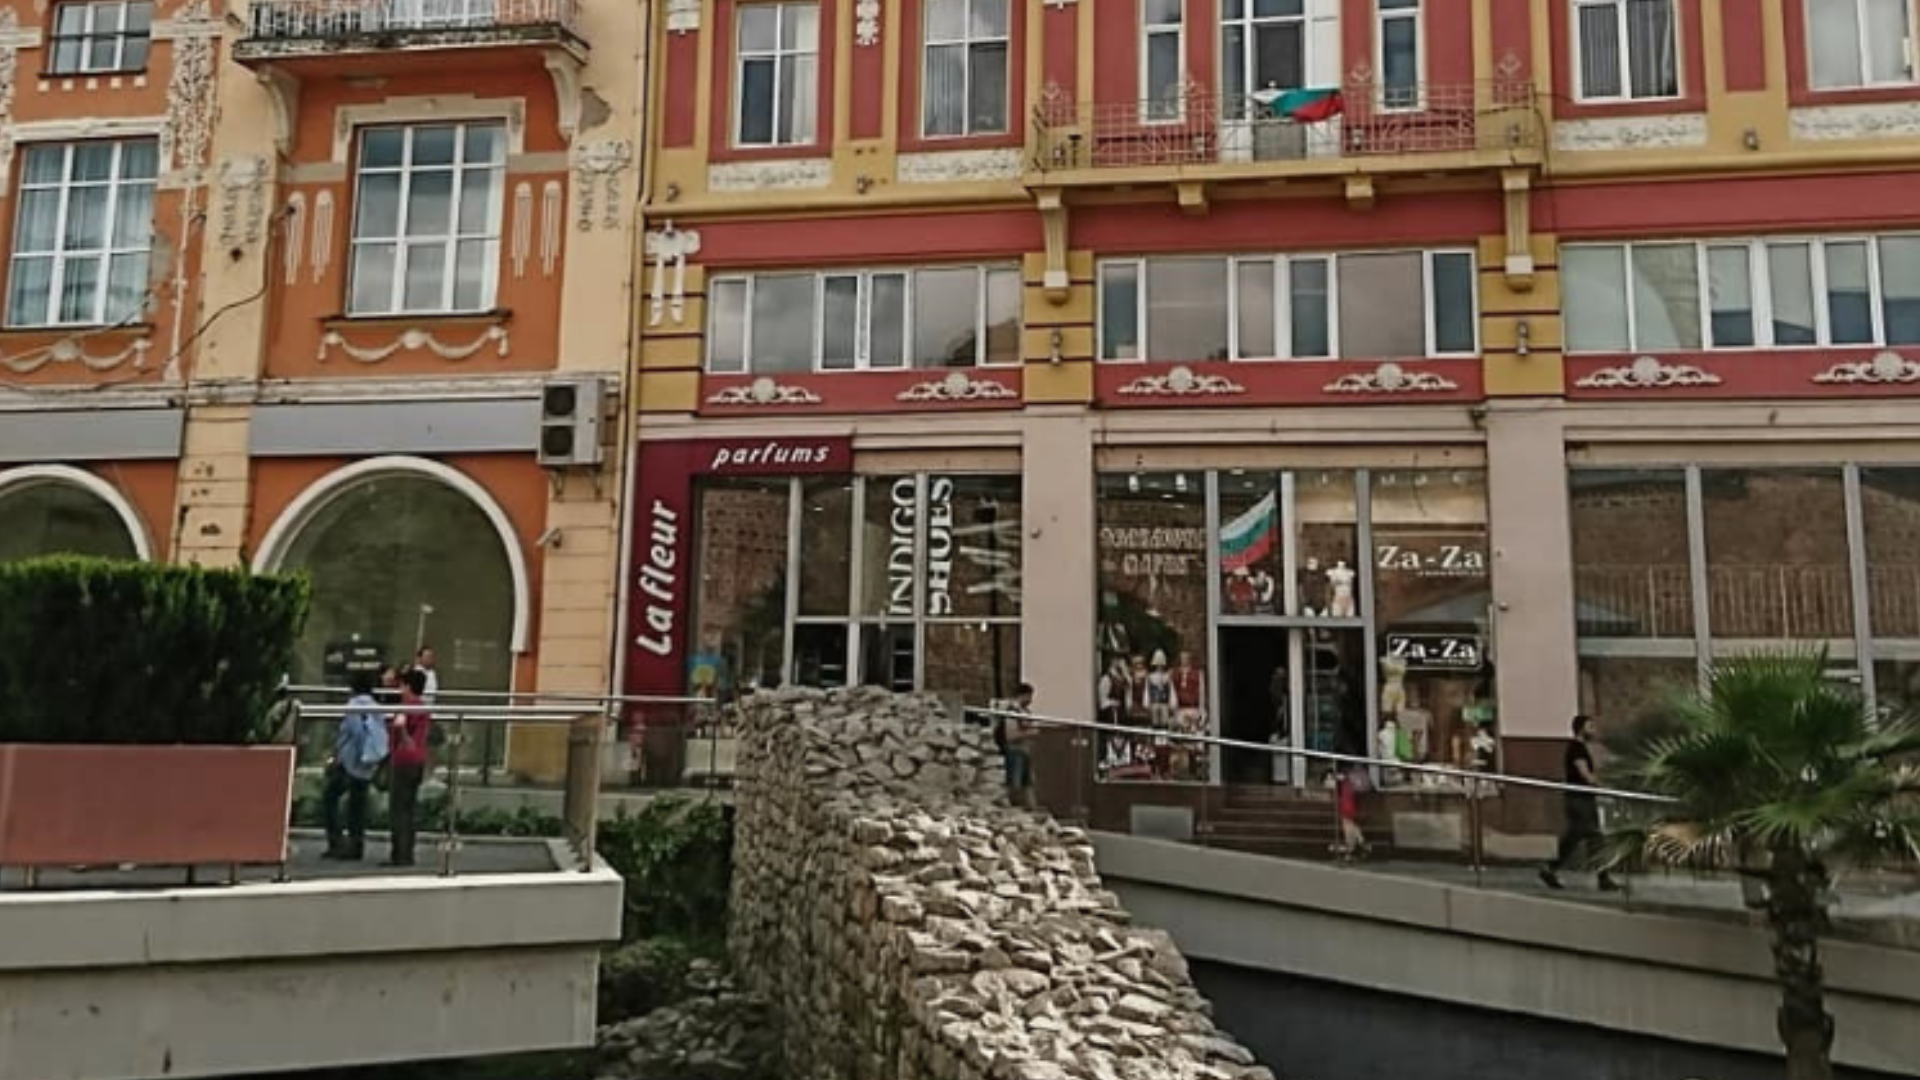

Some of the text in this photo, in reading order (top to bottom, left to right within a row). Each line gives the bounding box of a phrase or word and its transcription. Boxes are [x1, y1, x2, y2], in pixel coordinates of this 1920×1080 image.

[712, 443, 829, 469] parfums
[636, 500, 677, 656] La fleur
[889, 478, 914, 614] INDIGO
